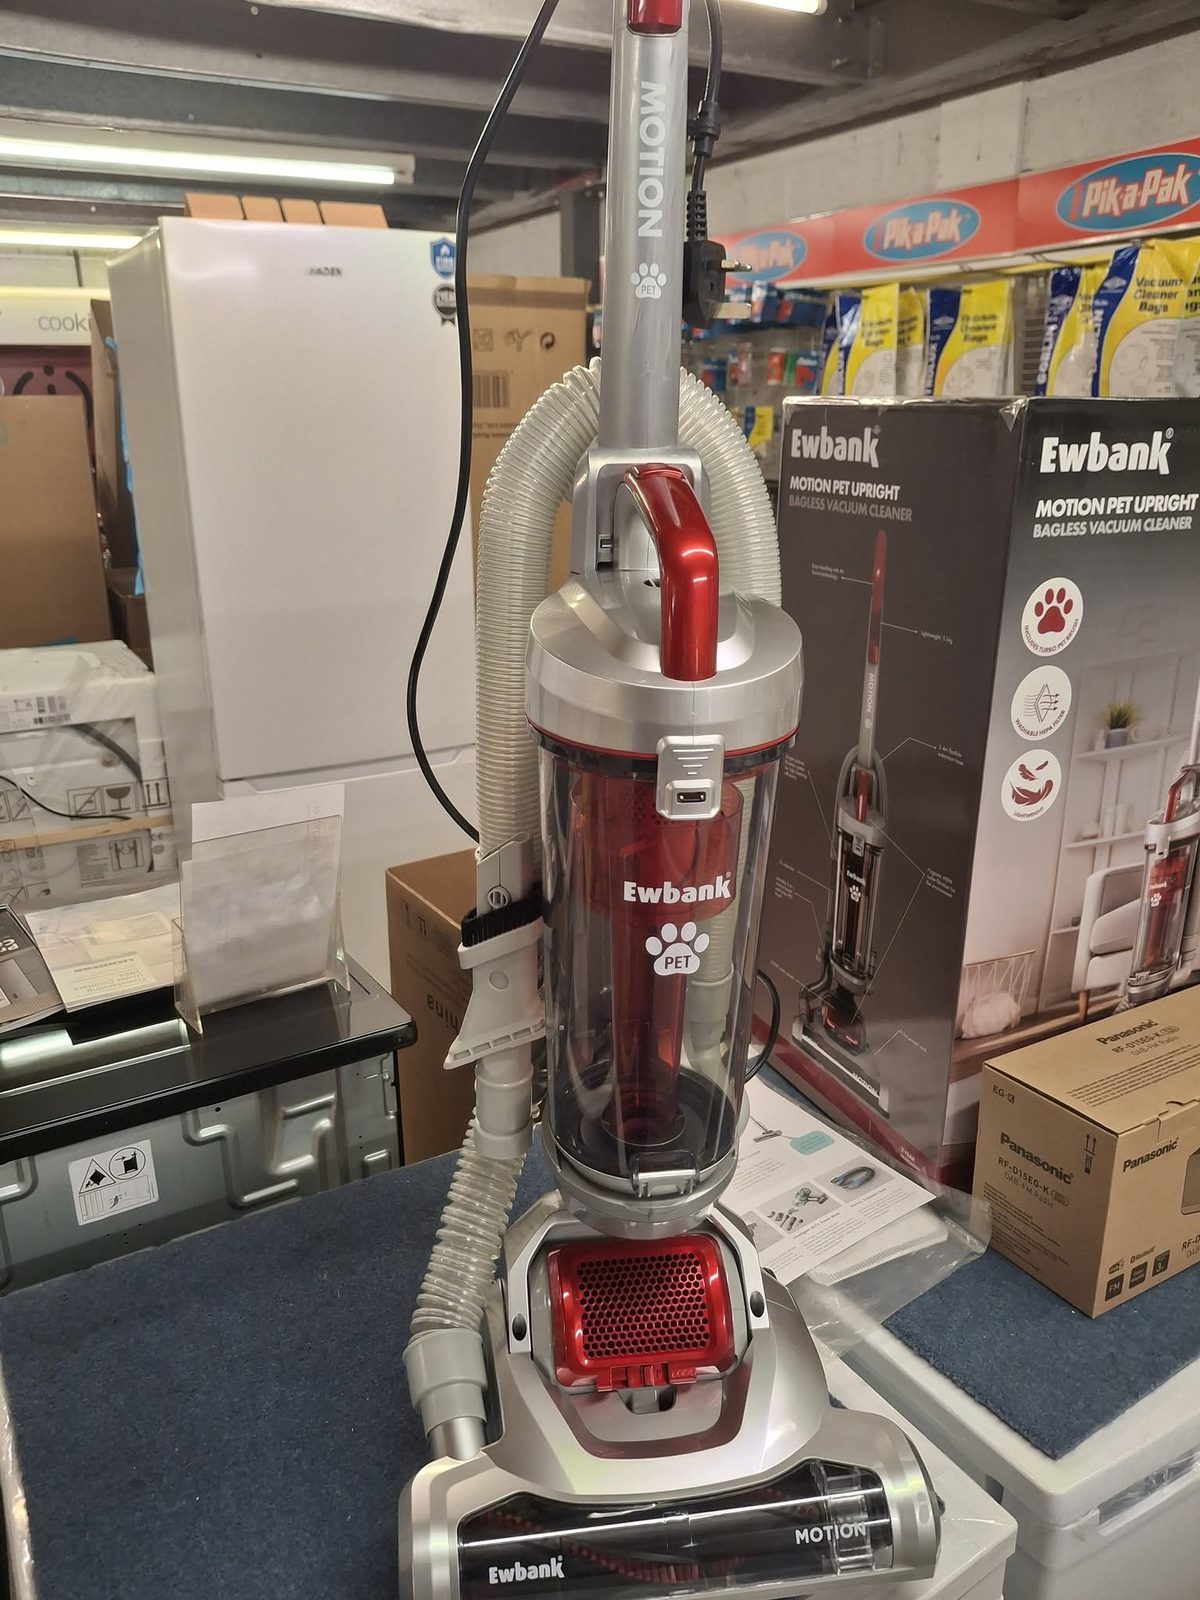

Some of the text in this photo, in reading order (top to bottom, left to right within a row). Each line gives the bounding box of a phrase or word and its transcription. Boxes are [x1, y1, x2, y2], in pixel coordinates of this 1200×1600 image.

[638, 81, 666, 237] MOTION
[641, 285, 656, 295] PET
[1139, 301, 1169, 315] Bags
[791, 426, 879, 468] Ewbank
[1040, 430, 1172, 475] Ewbank
[789, 475, 900, 501] MOTION PET UPRIGHT
[788, 494, 913, 522] BAGLESS VACUUM CLEANER
[1035, 493, 1199, 518] MOTION PET UPRIGHT
[1032, 516, 1193, 538] BAGLESS VACUUM CLEANER
[1015, 718, 1039, 738] WASHABLE
[624, 872, 731, 904] Ewbank
[664, 955, 691, 970] PET
[1096, 1019, 1158, 1045] Panasonic
[1000, 1132, 1074, 1185] Panasonic
[1122, 1136, 1179, 1172] Panasonic
[998, 1156, 1049, 1195] RF-D15EG-K
[795, 1522, 866, 1545] MOTION
[489, 1556, 565, 1584] Ewbank
